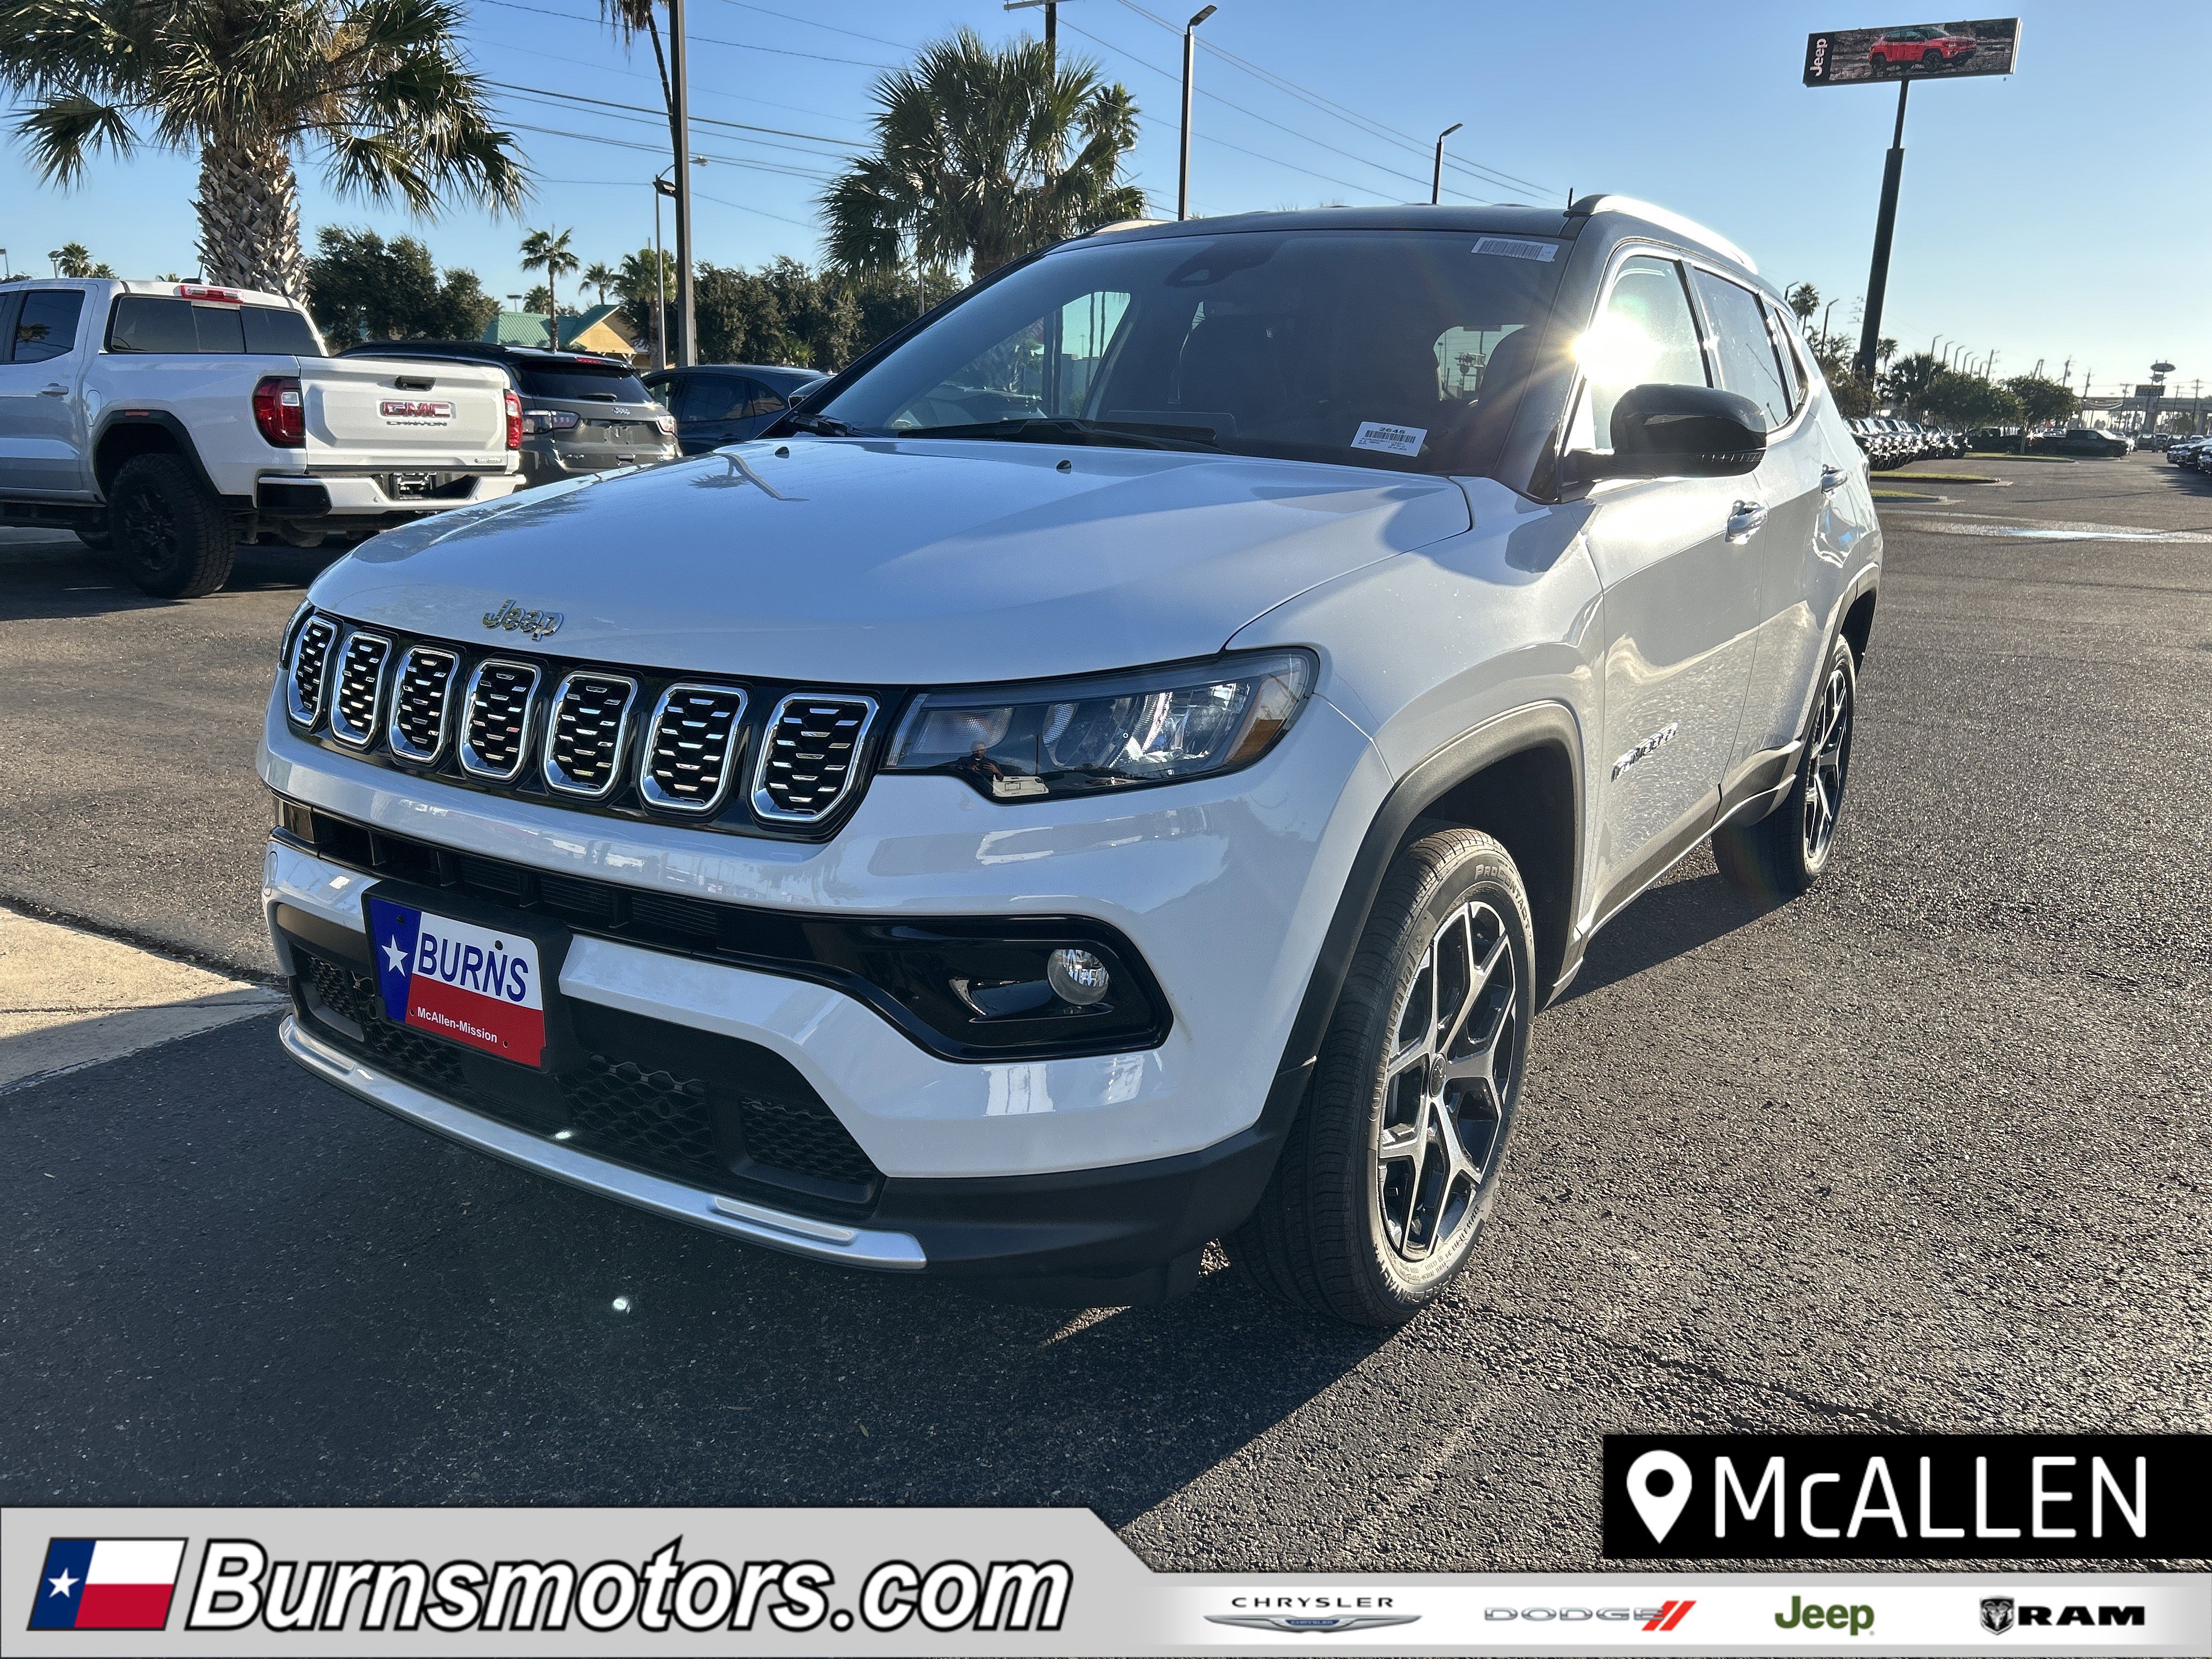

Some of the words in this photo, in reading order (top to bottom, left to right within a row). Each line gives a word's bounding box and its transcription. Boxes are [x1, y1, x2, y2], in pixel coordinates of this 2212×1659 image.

[1810, 38, 1829, 77] Jeep
[384, 402, 451, 418] GMC
[482, 599, 564, 642] Jeep
[417, 932, 529, 1002] BURNS
[417, 1006, 498, 1043] McAllen-Mission
